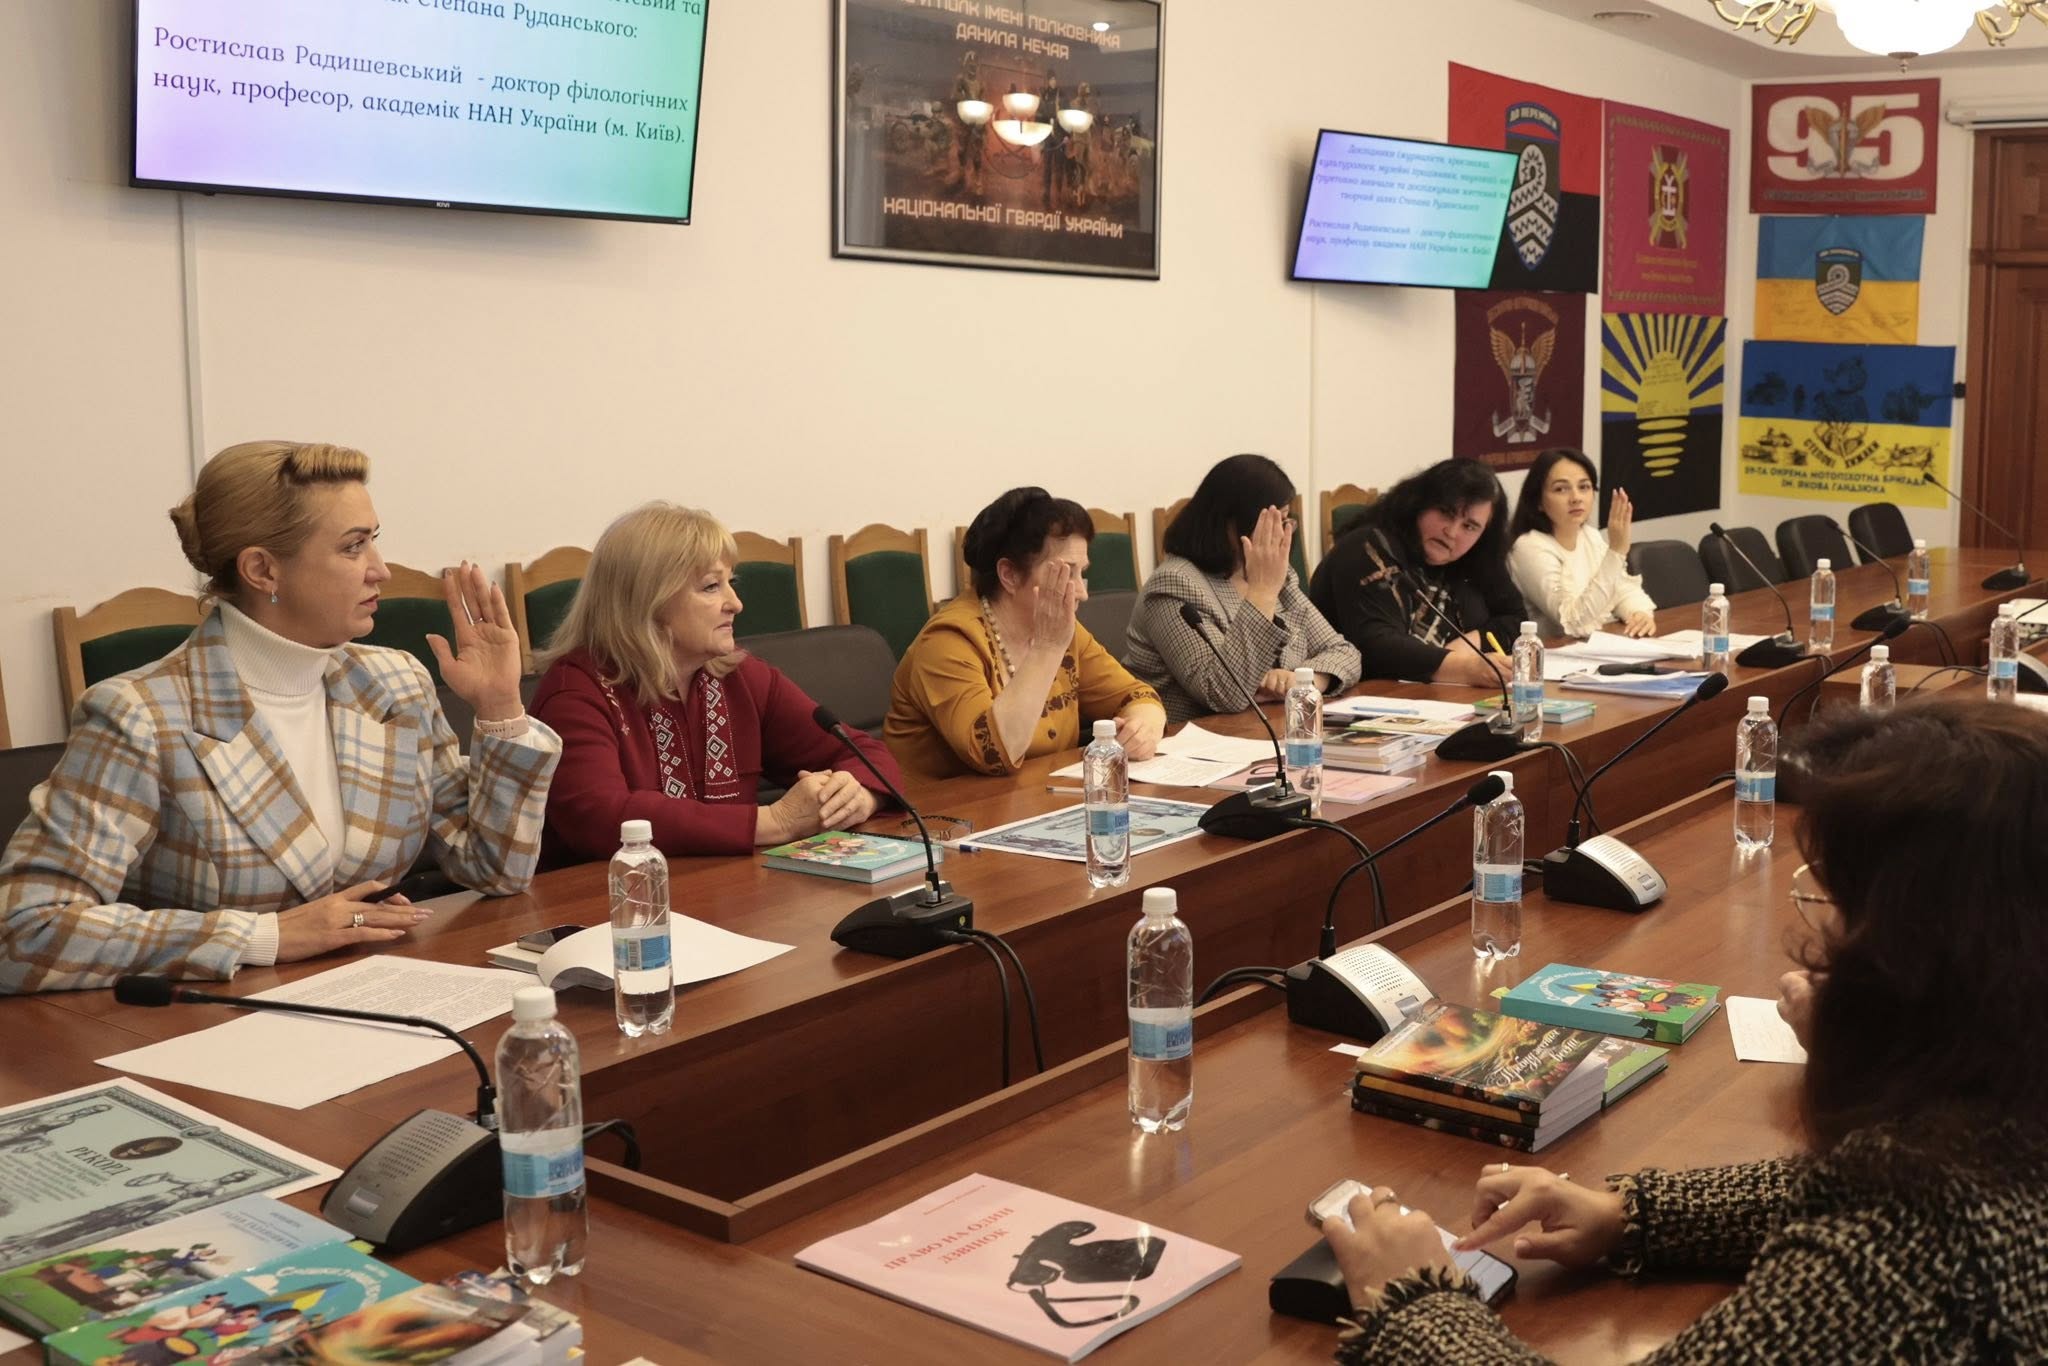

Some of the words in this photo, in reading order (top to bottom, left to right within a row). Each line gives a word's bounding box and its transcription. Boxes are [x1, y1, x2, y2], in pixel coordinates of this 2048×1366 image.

[514, 3, 637, 38] Руданського:
[682, 1, 700, 15] та
[985, 4, 1023, 26] ІМЕНІ
[1028, 13, 1120, 49] ПОЛКОВНИКА
[956, 22, 1017, 49] ДАНИЛА
[1022, 36, 1069, 60] НЕЧАЯ
[154, 27, 285, 62] Ростислав
[295, 45, 462, 84] Радишевський
[492, 75, 560, 100] доктор
[567, 80, 688, 111] філологічних
[153, 72, 221, 97] наук,
[232, 81, 353, 112] професор,
[362, 96, 459, 118] академік
[468, 103, 512, 124] НАН
[520, 108, 597, 134] України
[604, 118, 628, 137] (м.
[636, 121, 685, 143] Київ).
[1767, 93, 1924, 181] 95
[883, 197, 1001, 224] НАЦІОНАЛЬНОЇ
[1006, 208, 1061, 232] ГВАРДІЇ
[1065, 215, 1123, 239] УКРАЇНИ
